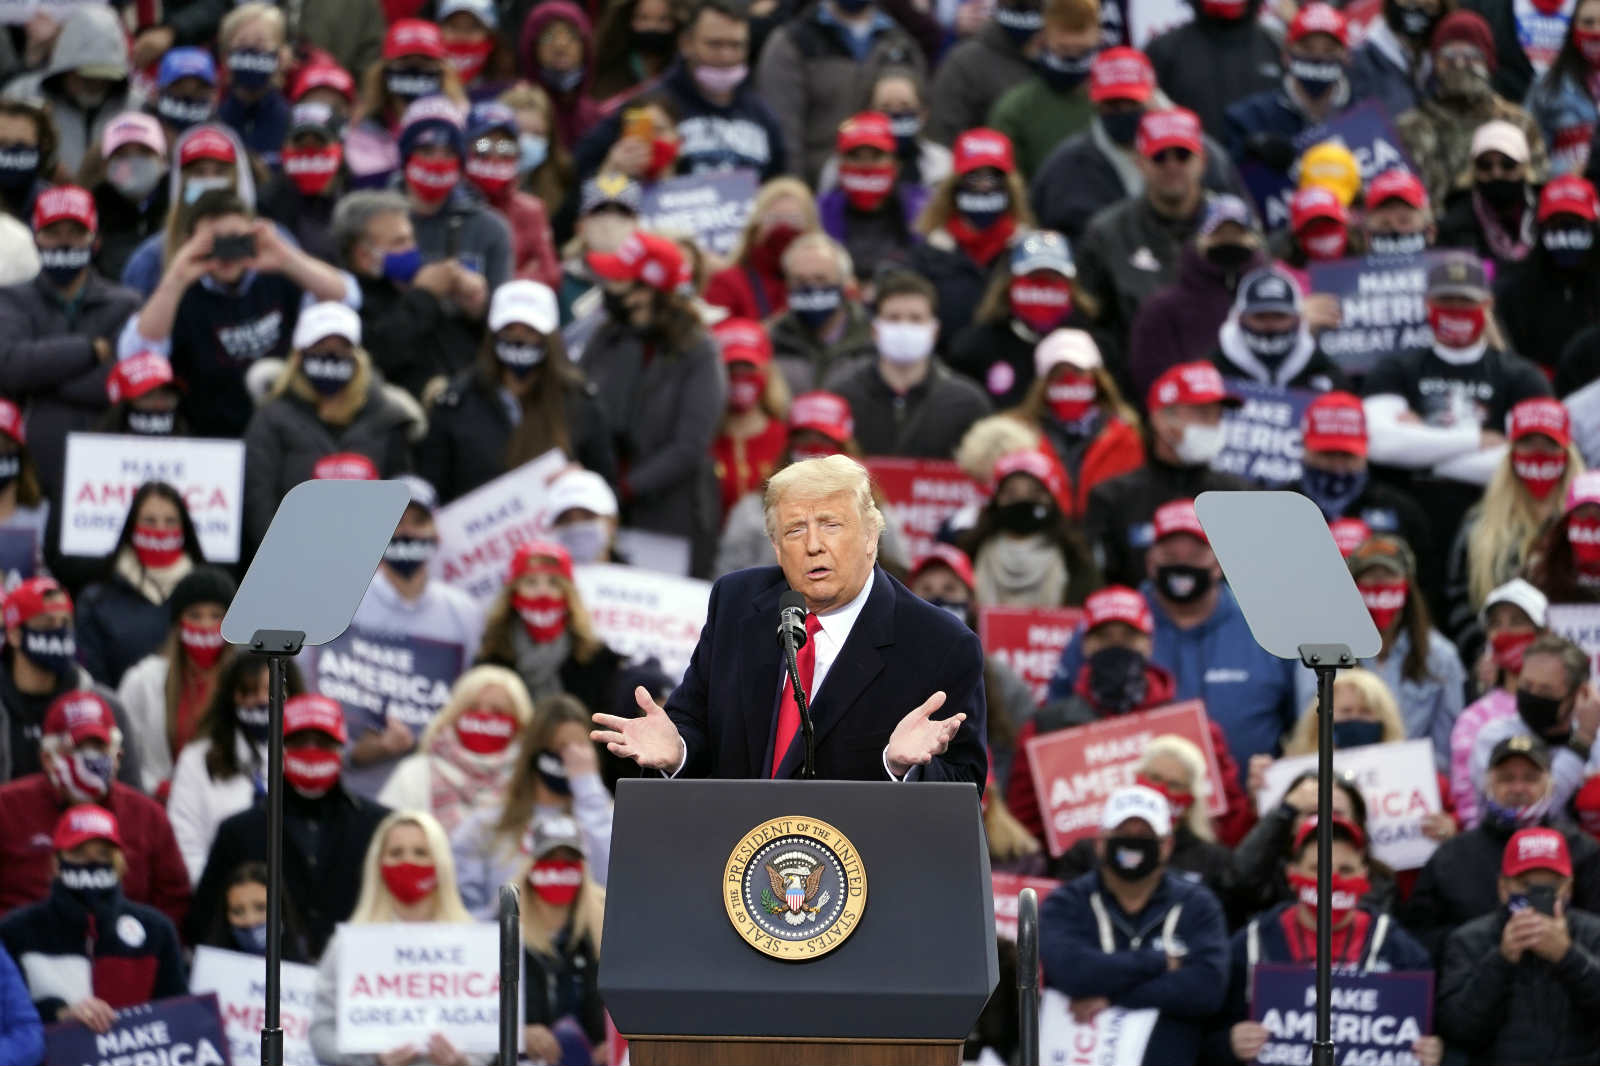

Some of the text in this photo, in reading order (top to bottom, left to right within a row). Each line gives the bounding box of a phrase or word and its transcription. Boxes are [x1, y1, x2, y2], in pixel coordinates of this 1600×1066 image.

[443, 510, 548, 582] AMERIC
[728, 821, 863, 953] SEAL OF THE PRESIDENT OF THE UNITED STATES
[394, 947, 465, 965] MAKE
[350, 973, 501, 999] AMERICA
[349, 1006, 426, 1027] GREAT
[96, 1021, 168, 1057] MAKE
